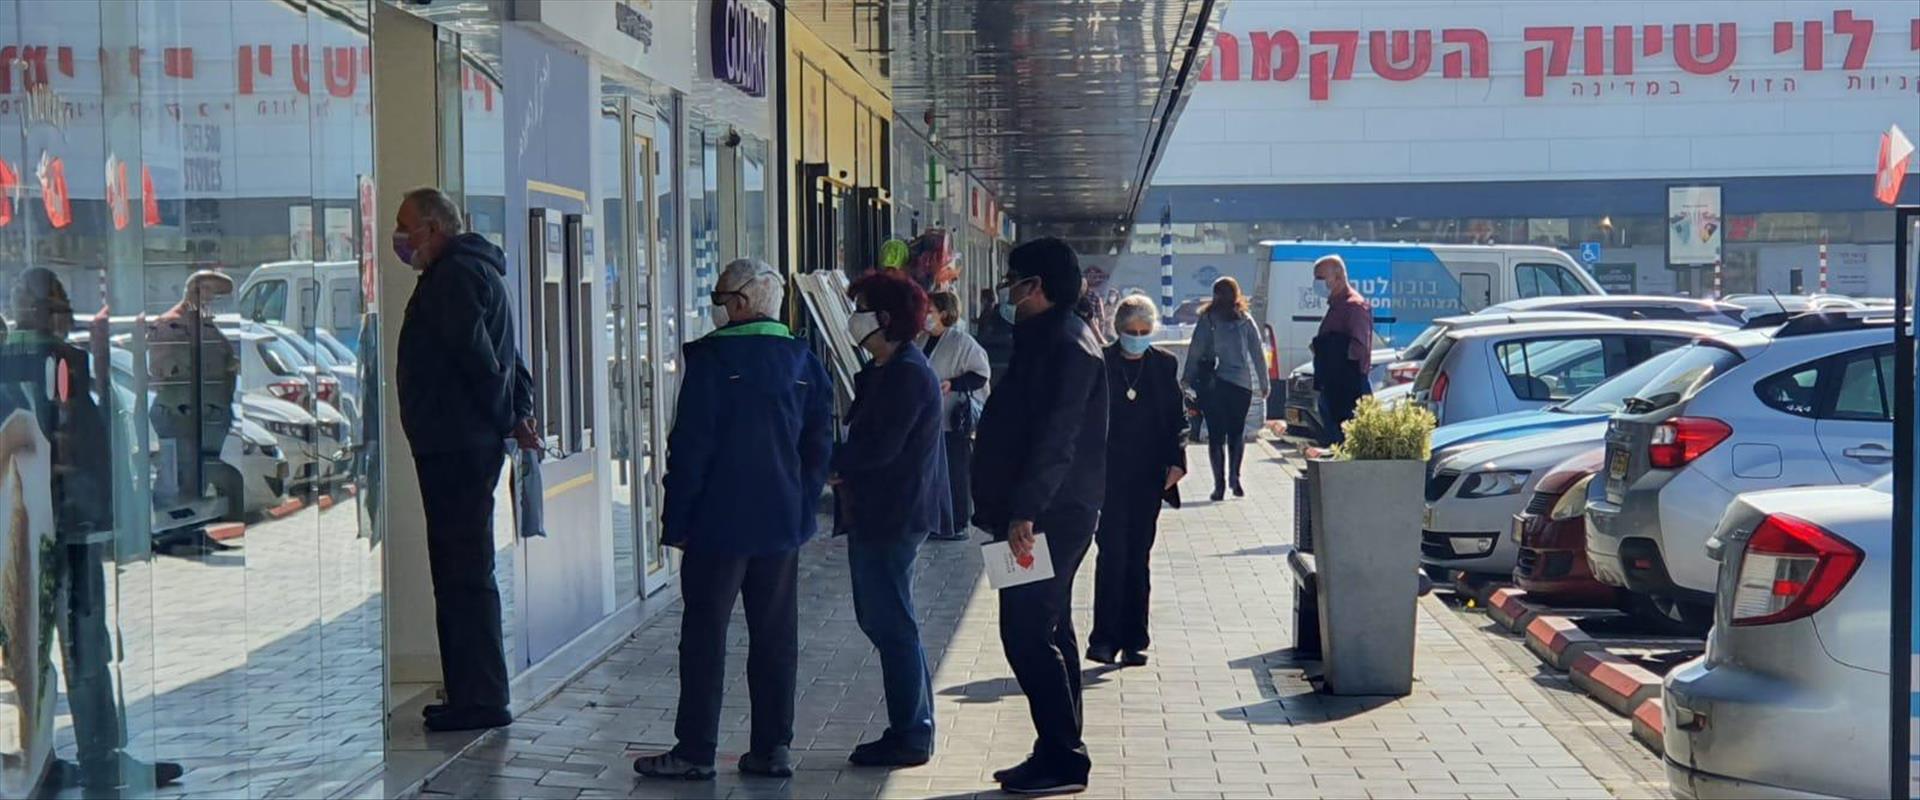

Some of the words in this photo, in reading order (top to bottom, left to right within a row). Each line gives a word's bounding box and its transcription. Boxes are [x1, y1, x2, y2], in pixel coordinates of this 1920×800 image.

[1524, 22, 1737, 97] שיווק
[1773, 10, 1874, 70] לוי
[1572, 80, 1681, 97] במדינה
[1729, 75, 1796, 93] הזול
